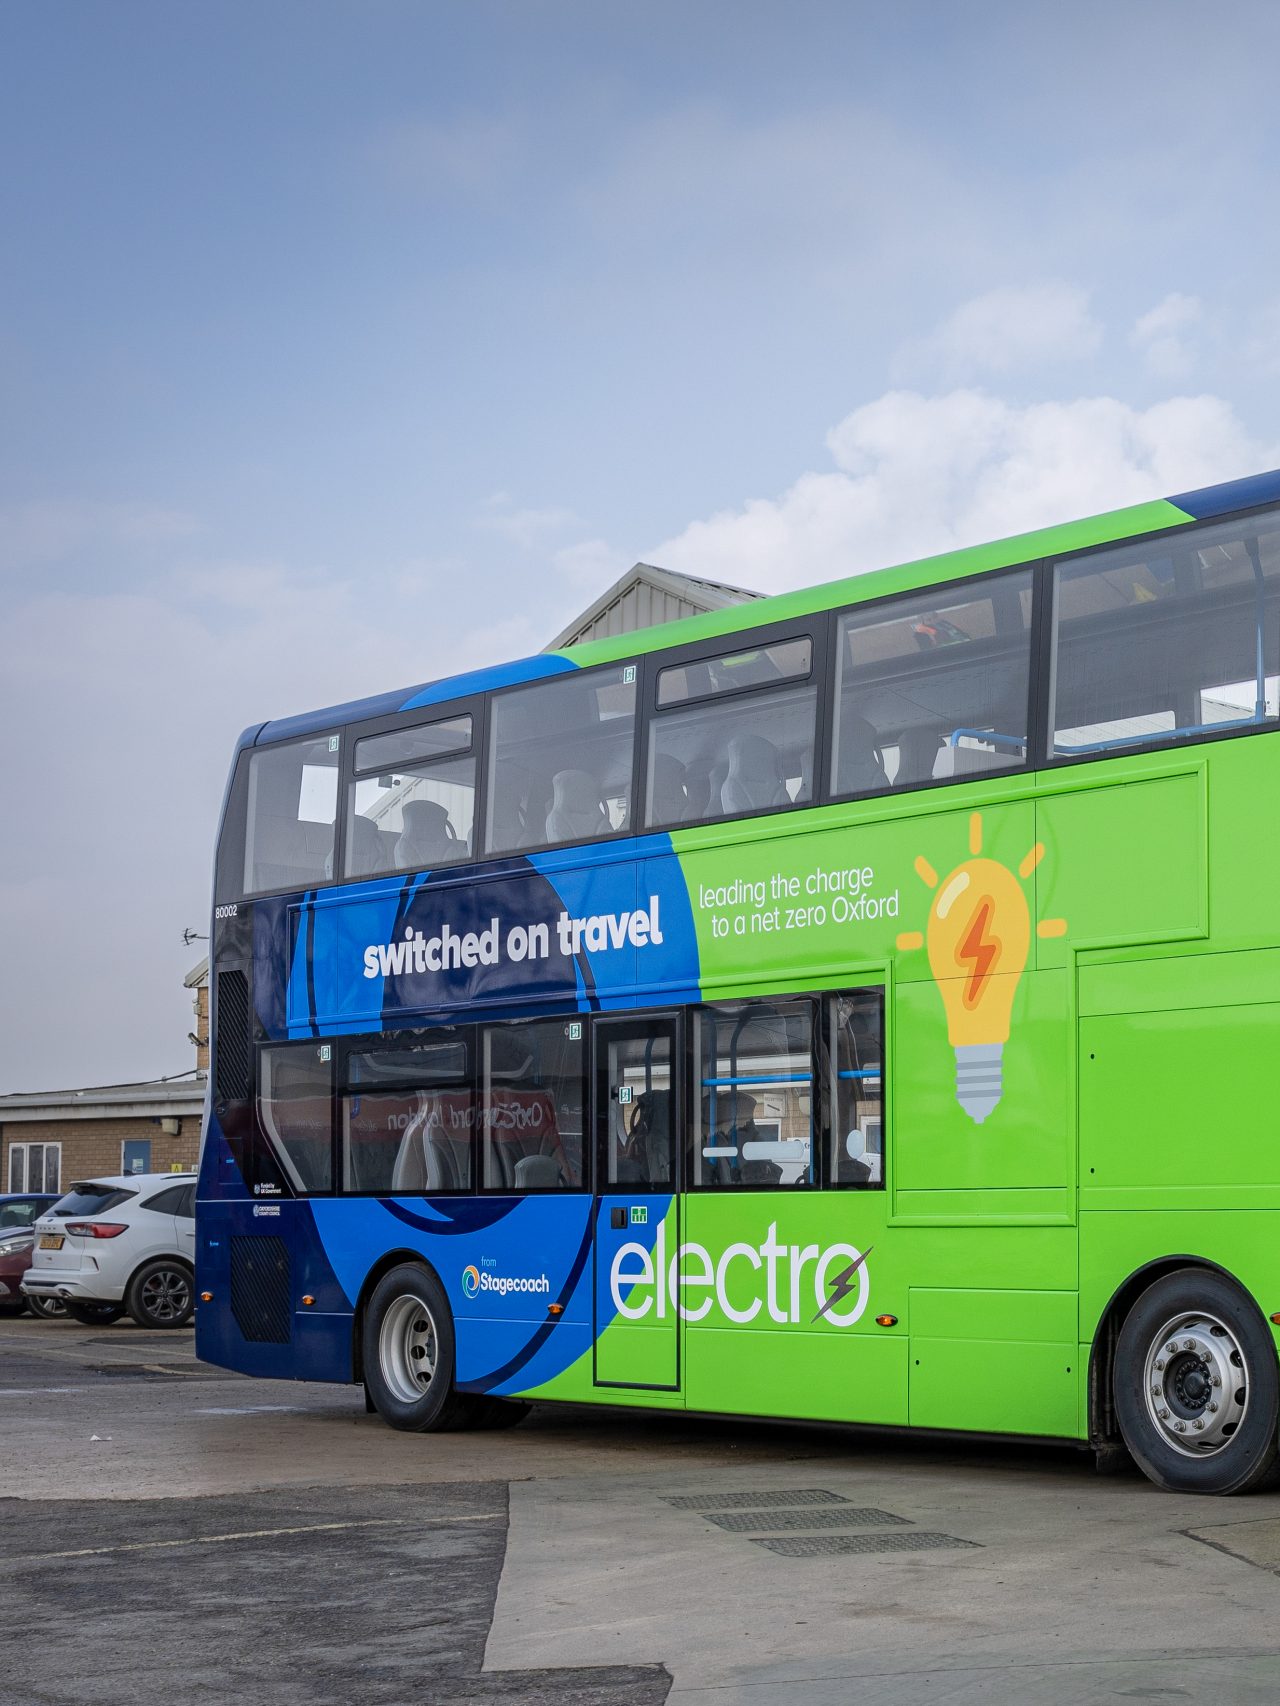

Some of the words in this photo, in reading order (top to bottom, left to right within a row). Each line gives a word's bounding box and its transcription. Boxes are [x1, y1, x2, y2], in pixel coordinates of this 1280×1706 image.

[699, 879, 766, 909] leading
[770, 873, 801, 899] the
[806, 866, 874, 896] charge
[215, 904, 238, 919] 80002
[711, 914, 730, 938] to
[734, 914, 746, 935] a
[751, 906, 780, 933] net
[785, 905, 827, 929] zero
[831, 889, 899, 923] Oxford
[363, 917, 500, 979] switched
[506, 921, 549, 962] on
[556, 894, 664, 956] travel
[481, 1256, 497, 1267] from
[610, 1218, 870, 1327] electro
[480, 1272, 550, 1296] Stagecoach
